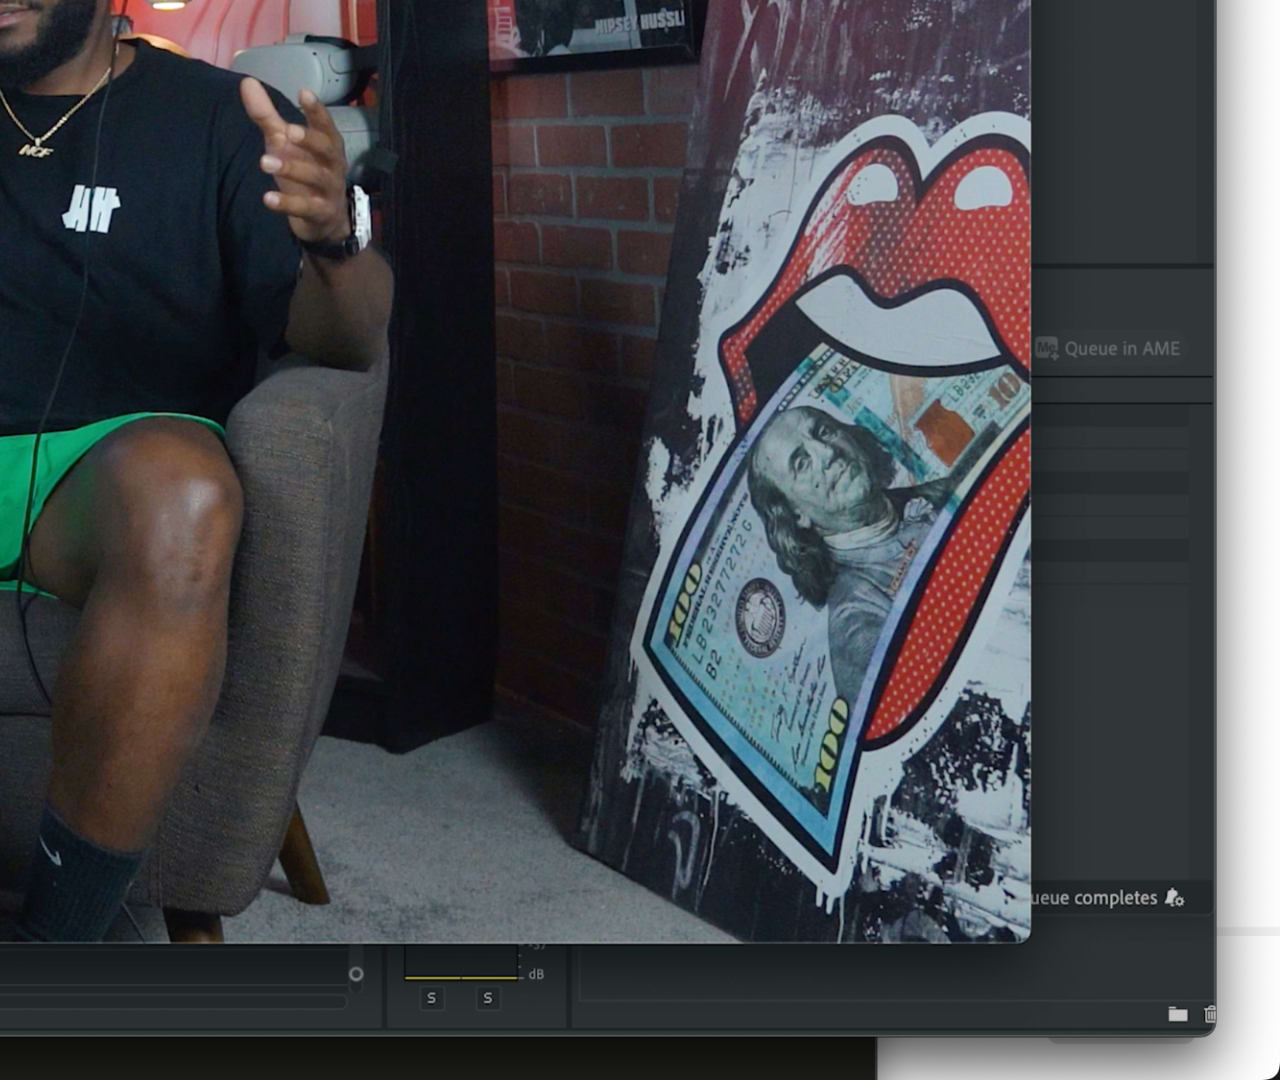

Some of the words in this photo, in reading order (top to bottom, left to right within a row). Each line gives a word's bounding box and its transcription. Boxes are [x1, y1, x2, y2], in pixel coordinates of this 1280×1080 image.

[1065, 341, 1117, 358] Queue
[1123, 341, 1137, 355] in
[1143, 341, 1180, 355] AME
[666, 563, 702, 646] 100
[814, 696, 850, 794] 100
[1075, 889, 1157, 909] completes
[529, 968, 544, 979] dB
